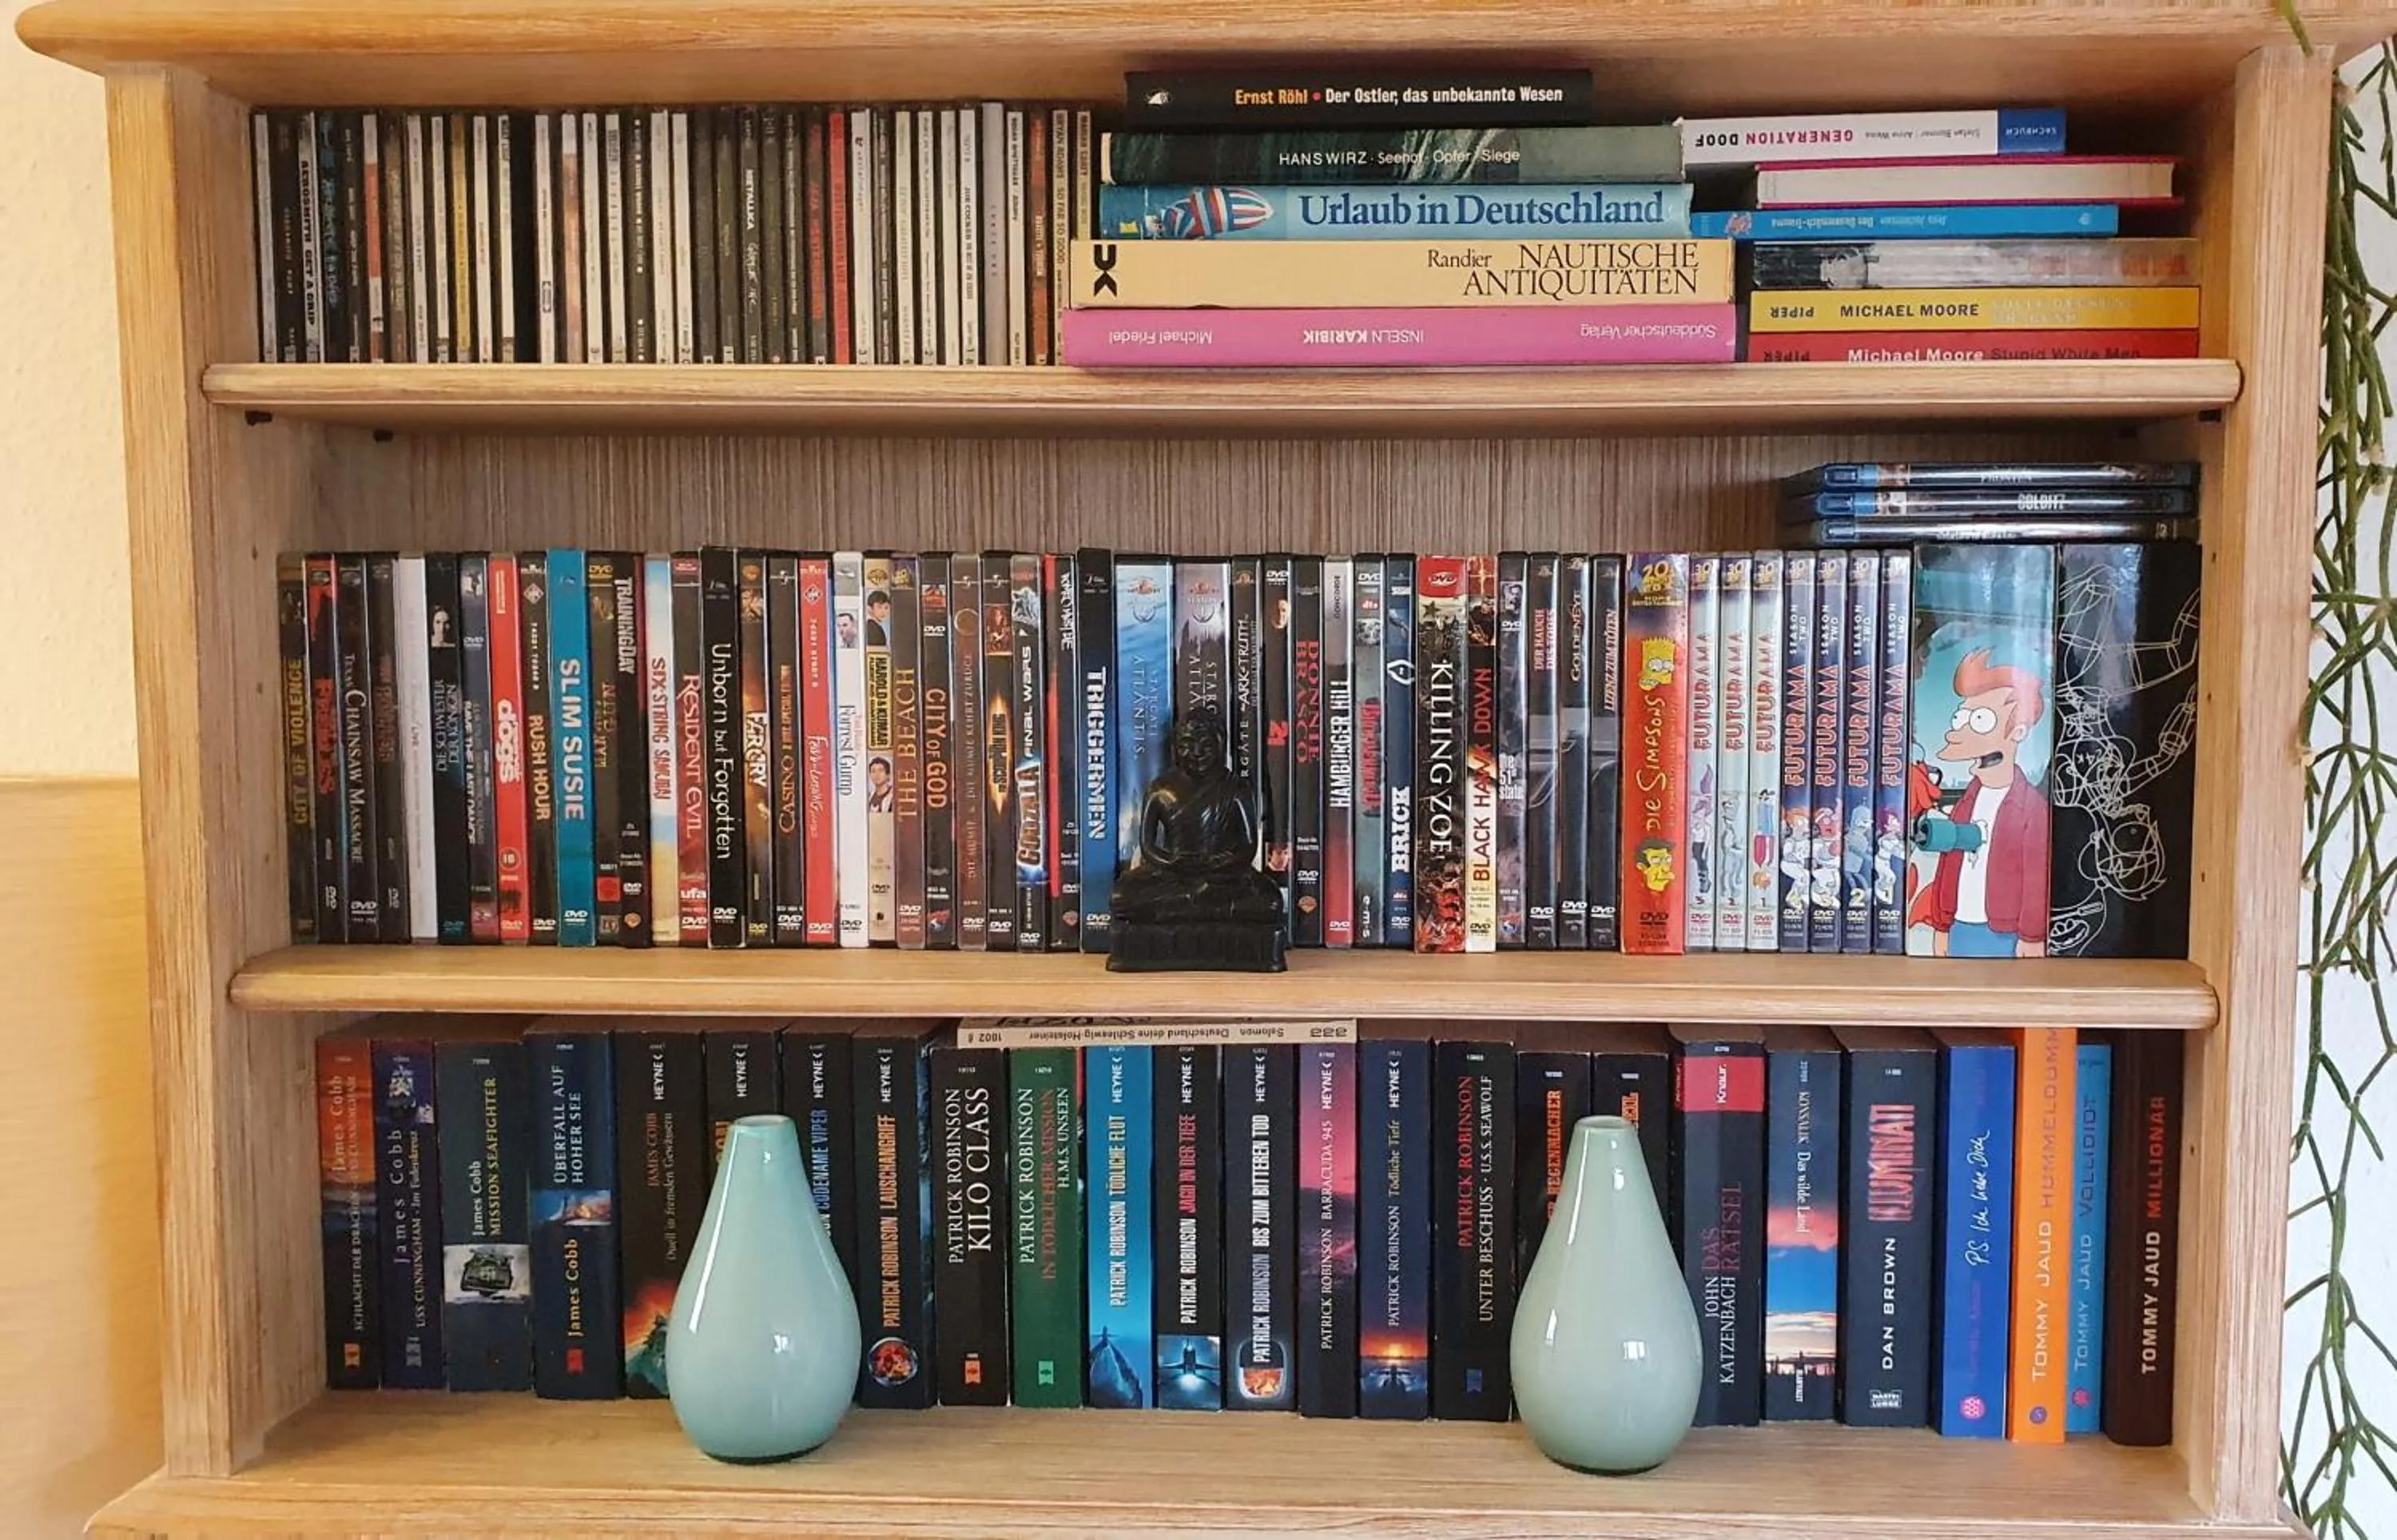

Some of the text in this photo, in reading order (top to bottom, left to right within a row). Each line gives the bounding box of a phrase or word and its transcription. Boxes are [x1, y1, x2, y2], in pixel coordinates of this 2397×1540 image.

[1234, 87, 1563, 106] Ernst Röhl Der Ostler, das unbekannte Wesen
[1695, 129, 1854, 146] GENERATION DOOF
[1057, 187, 1064, 200] SO
[1278, 152, 1322, 165] HANS
[1326, 152, 1365, 165] WIRZ
[1433, 149, 1471, 164] Opfer
[1482, 148, 1520, 163] Siege
[1058, 223, 1064, 233] SO
[1300, 191, 1664, 226] Urlaub in Deutschland
[1427, 243, 1699, 270] Randier NAUTISCHE
[1463, 264, 1698, 299] ANTIQUITÄTEN
[1581, 324, 1716, 339] Süddeutscher Verlag
[1771, 306, 1815, 318] PIPER
[1840, 304, 1914, 318] MICHAEL
[1919, 304, 1978, 316] MOORE
[1108, 330, 1212, 344] Michael Friedel
[1303, 330, 1424, 343] INSELN KARIBIK
[1849, 348, 1919, 362] Michael
[1926, 348, 1984, 360] Moore
[288, 658, 304, 745] VIOLENCE
[495, 700, 515, 783] dogs
[560, 659, 585, 820] SLIM SUSIE
[873, 657, 888, 746] HAROLD KUMAR
[1296, 641, 1307, 764] BRASCO
[1308, 641, 1319, 762] DONNIE
[1693, 633, 1713, 750] FUTURAMA
[1725, 632, 1744, 751] FUTURAMA
[1756, 633, 1775, 752] FUTURAMA
[1785, 604, 1807, 787] FUTURAMA SEASON
[1816, 665, 1838, 787] FUTURAMA
[529, 716, 550, 820] RUSH HOUR
[675, 674, 702, 839] RESIDENT EVIL
[711, 643, 735, 859] Unborn but Forgotten
[780, 755, 796, 832] CASINO
[837, 705, 857, 796] Forrest Gump
[896, 668, 918, 821] THE BEACH
[926, 689, 947, 808] CITY GOD
[1087, 668, 1106, 839] TRIGGERMEN
[1330, 717, 1350, 808] HAMBURGER
[1429, 660, 1453, 853] KILLING ZOE
[1473, 669, 1490, 882] BLACK HAWK DOWN
[1391, 788, 1411, 873] BRICK
[980, 1033, 1002, 1042] 1002
[1137, 1029, 1165, 1039] deine
[1167, 1028, 1229, 1039] Deutschland
[1240, 1027, 1284, 1037] Salomon
[330, 1075, 343, 1116] Cobb
[551, 1064, 568, 1182] ÜBERFALL AUF
[568, 1093, 584, 1182] HOHER SEE
[812, 1109, 828, 1144] VIPER
[1056, 1087, 1070, 1141] UNSEEN
[388, 1129, 407, 1263] James Cobb
[469, 1161, 484, 1236] James Cobb
[483, 1078, 502, 1236] MISSION SEAFIGHTER
[944, 1089, 964, 1263] PATRICK ROBINSON
[965, 1086, 992, 1252] KILO CLASS
[1018, 1088, 1036, 1263] PATRICK ROBINSON
[1320, 1120, 1333, 1220] BARRACUDA 945
[1478, 1076, 1494, 1322] UNTER BESCHUSS SEAWOLF
[877, 1113, 900, 1327] PATRICK ROBINSON LAUSCHANGRIFF
[1108, 1115, 1126, 1306] PATRICK ROBINSON FLUT
[1179, 1113, 1197, 1324] PATRICK ROBINSON TIEFE
[1253, 1114, 1270, 1363] PATRICK ROBINSON BIS ZUM BITTEREN TOD
[2073, 1094, 2097, 1370] TOMMY JAUD VOLLIDIOT
[565, 1239, 586, 1337] James Cobb
[1704, 1276, 1719, 1317] JOHN
[1719, 1276, 1735, 1383] KATZENBACH
[1882, 1238, 1896, 1369] DAN BROWN
[2032, 1220, 2052, 1383] TOMMY JAUD
[2141, 1231, 2160, 1374] TOMMY JAUD
